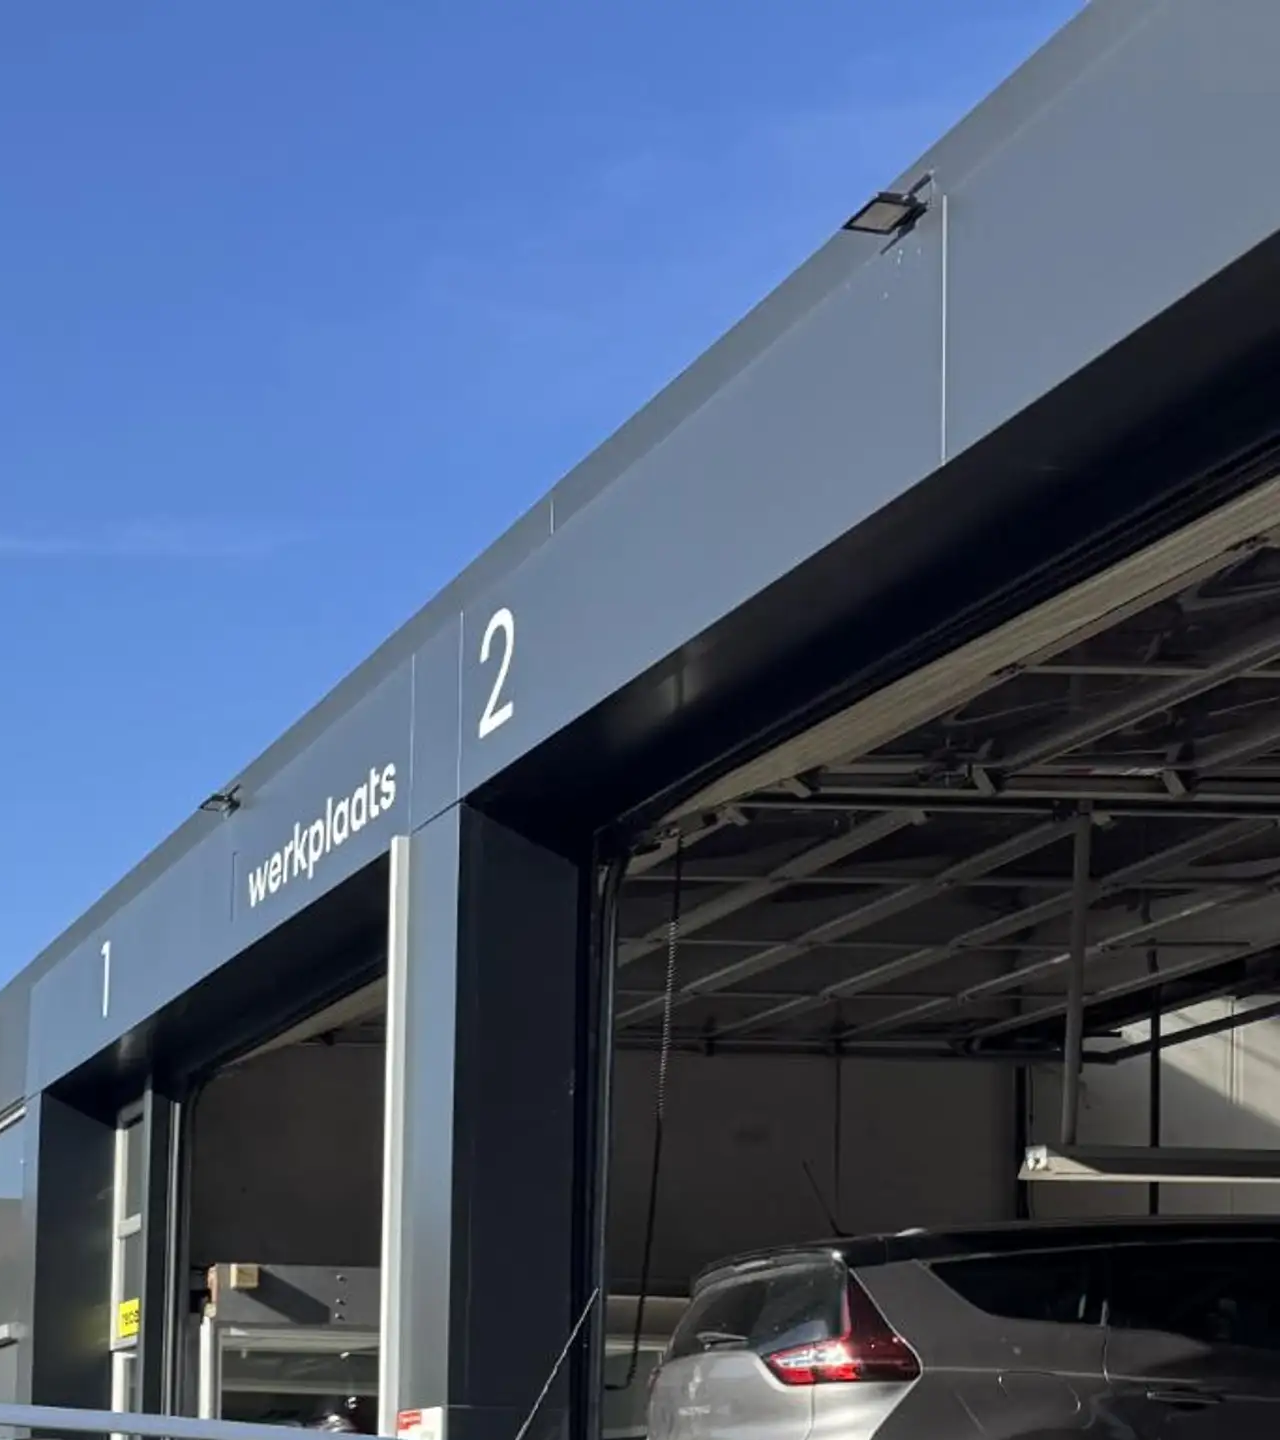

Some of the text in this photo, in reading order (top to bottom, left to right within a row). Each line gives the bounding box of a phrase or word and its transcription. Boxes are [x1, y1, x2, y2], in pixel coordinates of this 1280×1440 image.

[479, 607, 515, 739] 2
[248, 763, 396, 908] werkplaats
[101, 941, 111, 1017] 1
